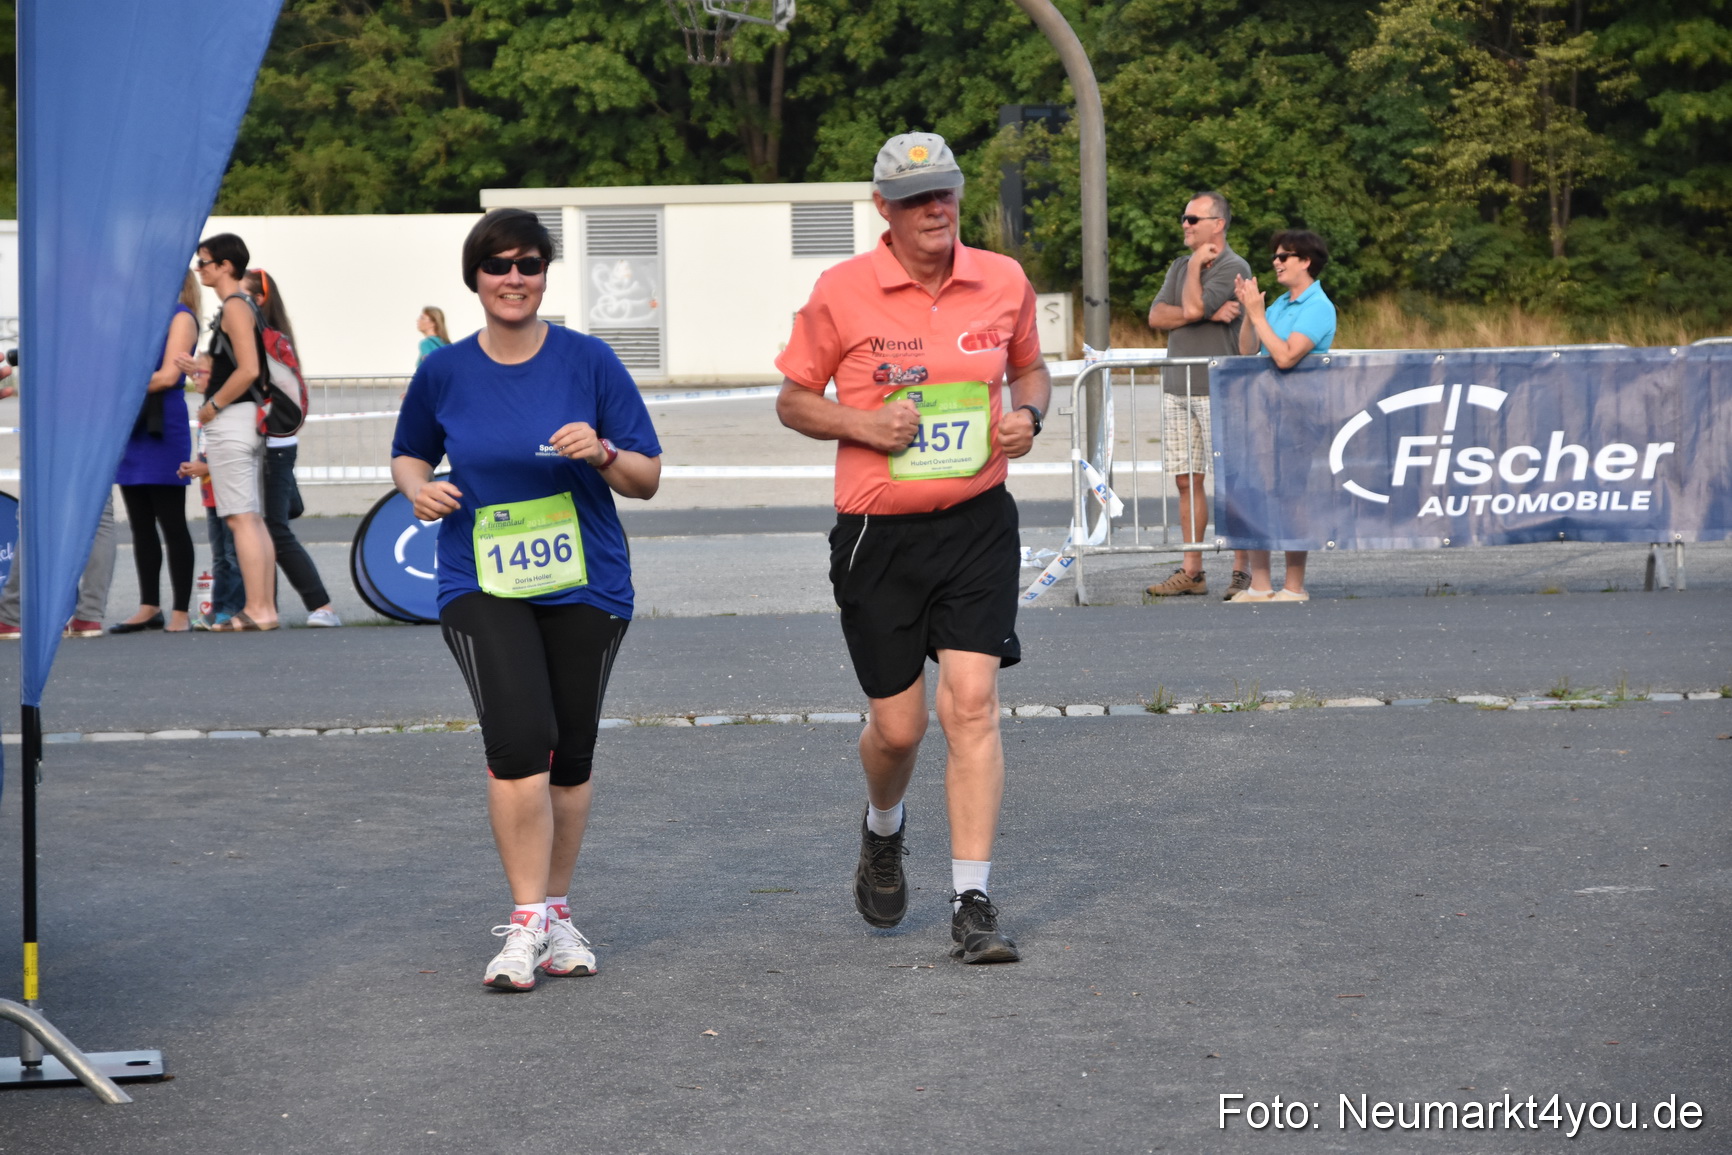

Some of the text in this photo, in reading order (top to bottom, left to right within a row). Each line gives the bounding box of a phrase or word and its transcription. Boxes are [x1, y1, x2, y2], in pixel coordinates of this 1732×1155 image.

[869, 337, 923, 352] Wendl
[933, 457, 972, 465] Ovenhausen
[1392, 430, 1676, 487] Fischer
[1417, 490, 1652, 517] AUTOMOBILE
[487, 533, 572, 573] 1496
